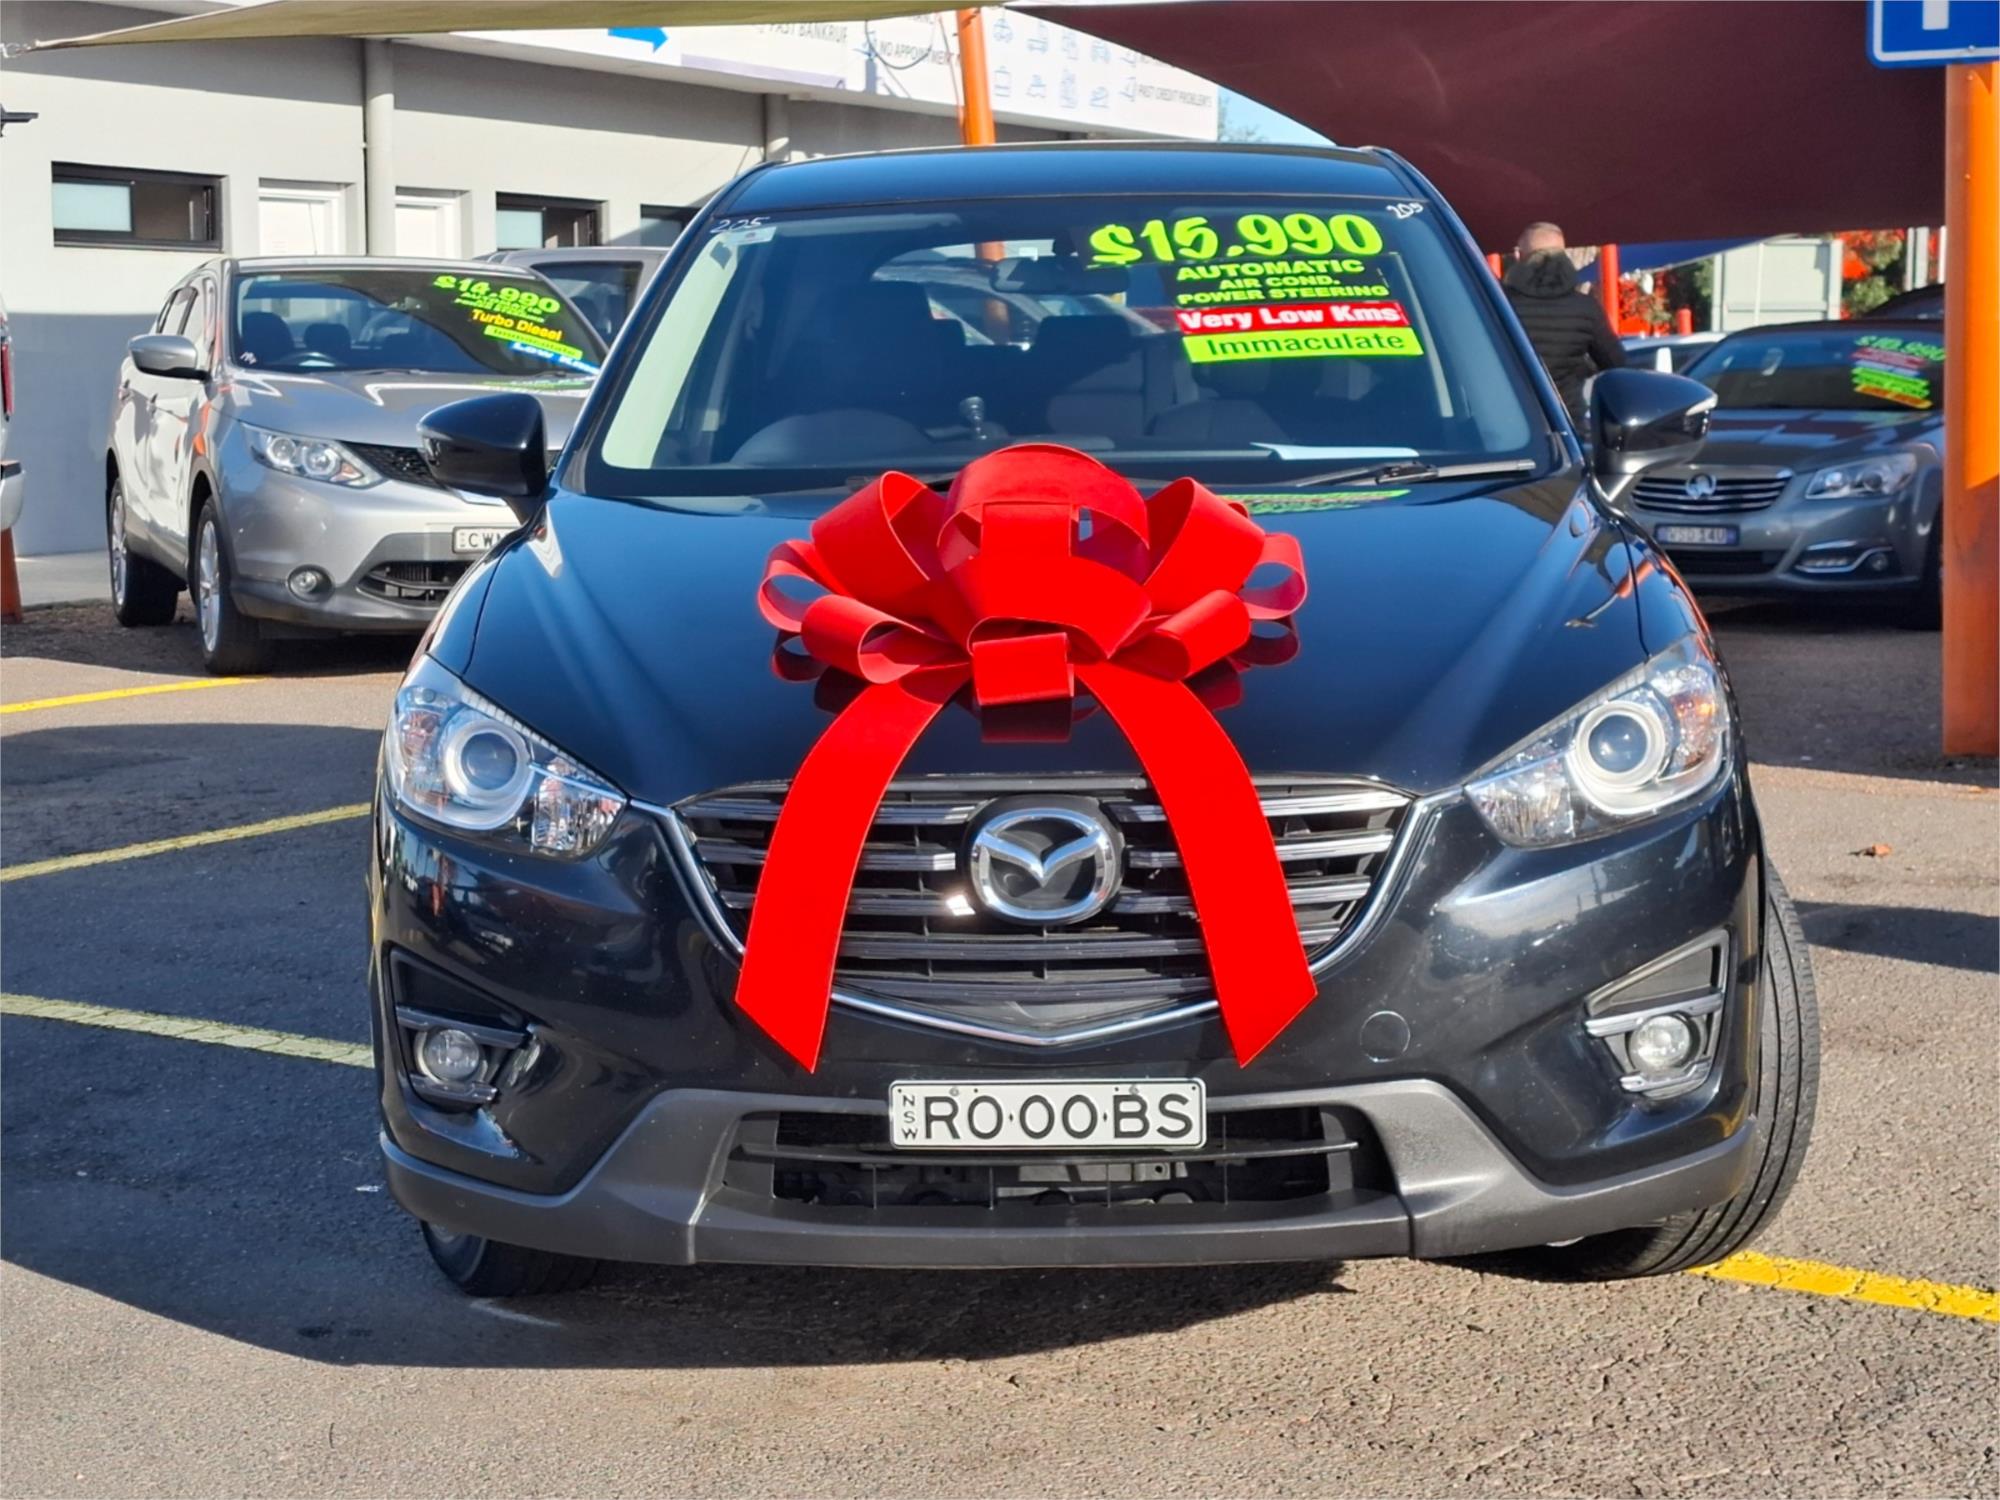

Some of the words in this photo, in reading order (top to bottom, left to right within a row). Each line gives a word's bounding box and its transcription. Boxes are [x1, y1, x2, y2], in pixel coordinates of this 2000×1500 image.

[1177, 259, 1365, 281] AUTOMATIC
[1220, 278, 1262, 290] AIR
[1265, 275, 1341, 287] COND.
[1177, 289, 1265, 305] POWER
[1268, 285, 1389, 300] STEERING
[472, 308, 515, 328] Turbo
[516, 320, 563, 342] Diesel
[1178, 312, 1253, 330] Very
[1258, 307, 1323, 325] Low
[1329, 304, 1401, 322] Kms
[1205, 332, 1406, 356] Immaculate
